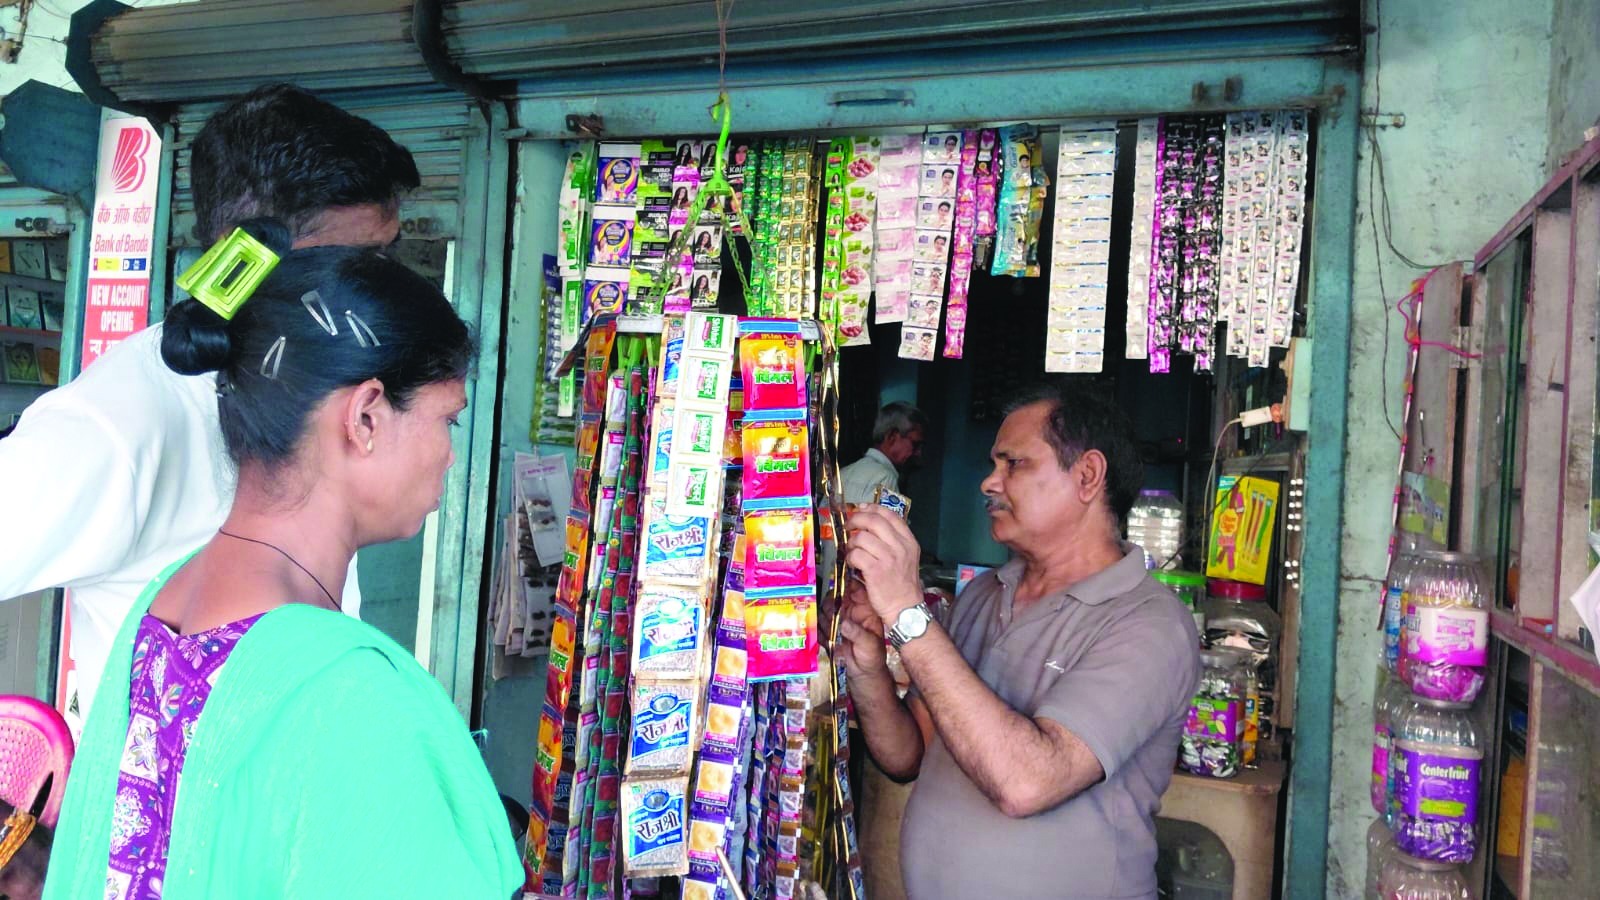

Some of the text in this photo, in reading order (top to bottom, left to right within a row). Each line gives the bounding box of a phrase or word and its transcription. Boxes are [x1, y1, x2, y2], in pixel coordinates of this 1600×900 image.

[94, 234, 149, 252] Bank of Baroda
[91, 285, 146, 307] NEW ACCOUNT
[101, 310, 134, 332] OPENING
[754, 366, 794, 384] विमल
[756, 456, 798, 473] विमल
[757, 544, 803, 562] विमल
[634, 810, 679, 840] राजश्री
